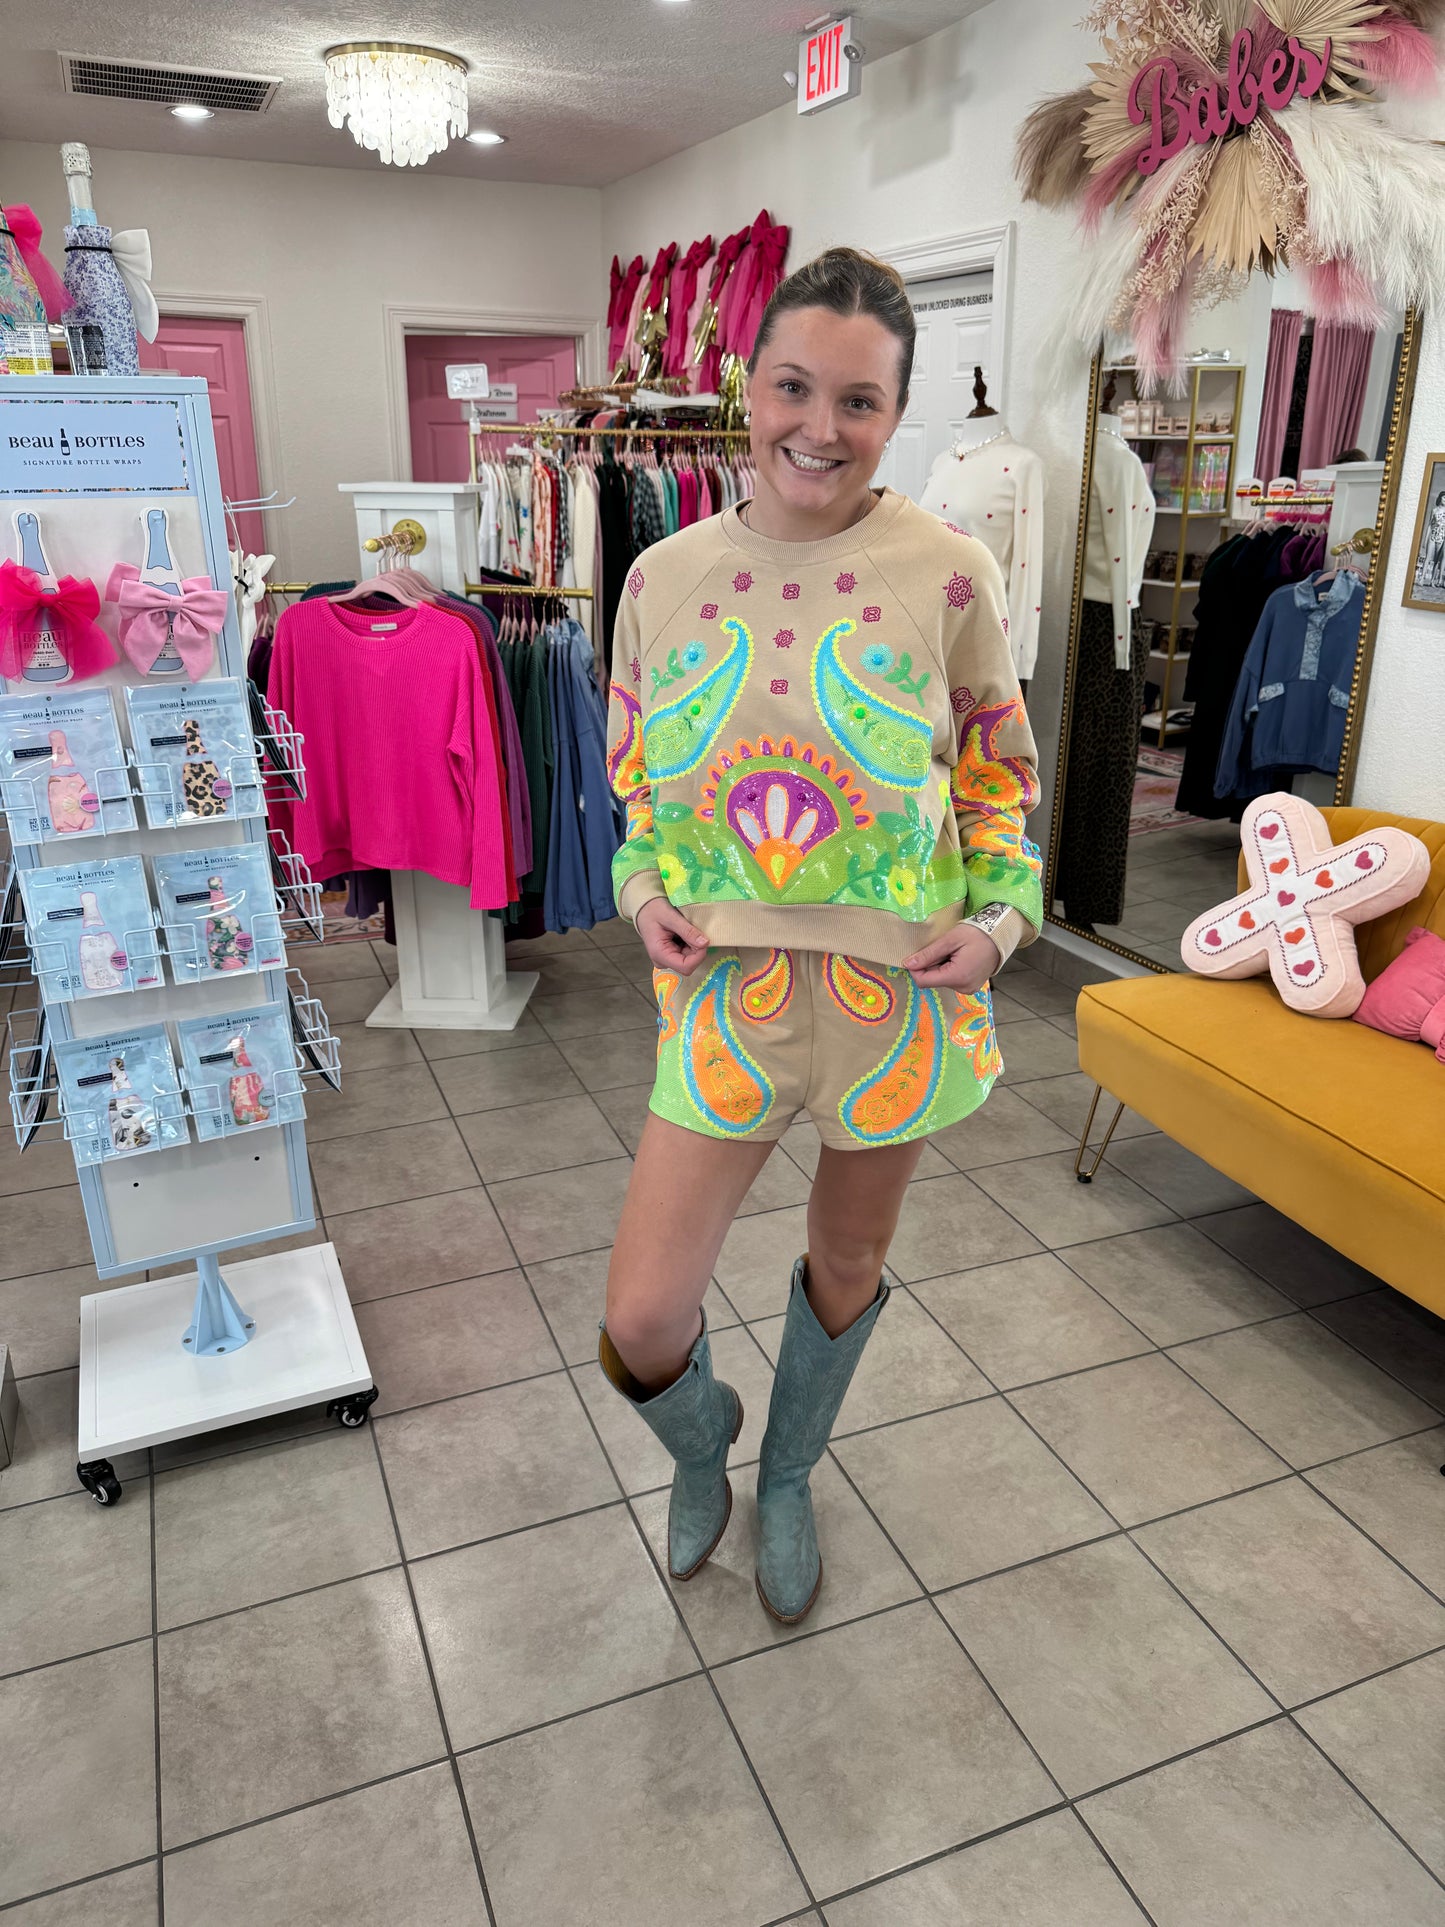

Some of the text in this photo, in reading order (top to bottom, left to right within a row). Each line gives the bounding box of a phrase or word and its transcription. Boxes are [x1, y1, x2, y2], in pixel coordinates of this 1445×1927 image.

[806, 24, 844, 101] EXIT
[1127, 27, 1332, 175] Babes
[928, 299, 950, 311] UNLOCKED
[950, 297, 966, 308] DURING
[967, 294, 988, 306] BUSINESS
